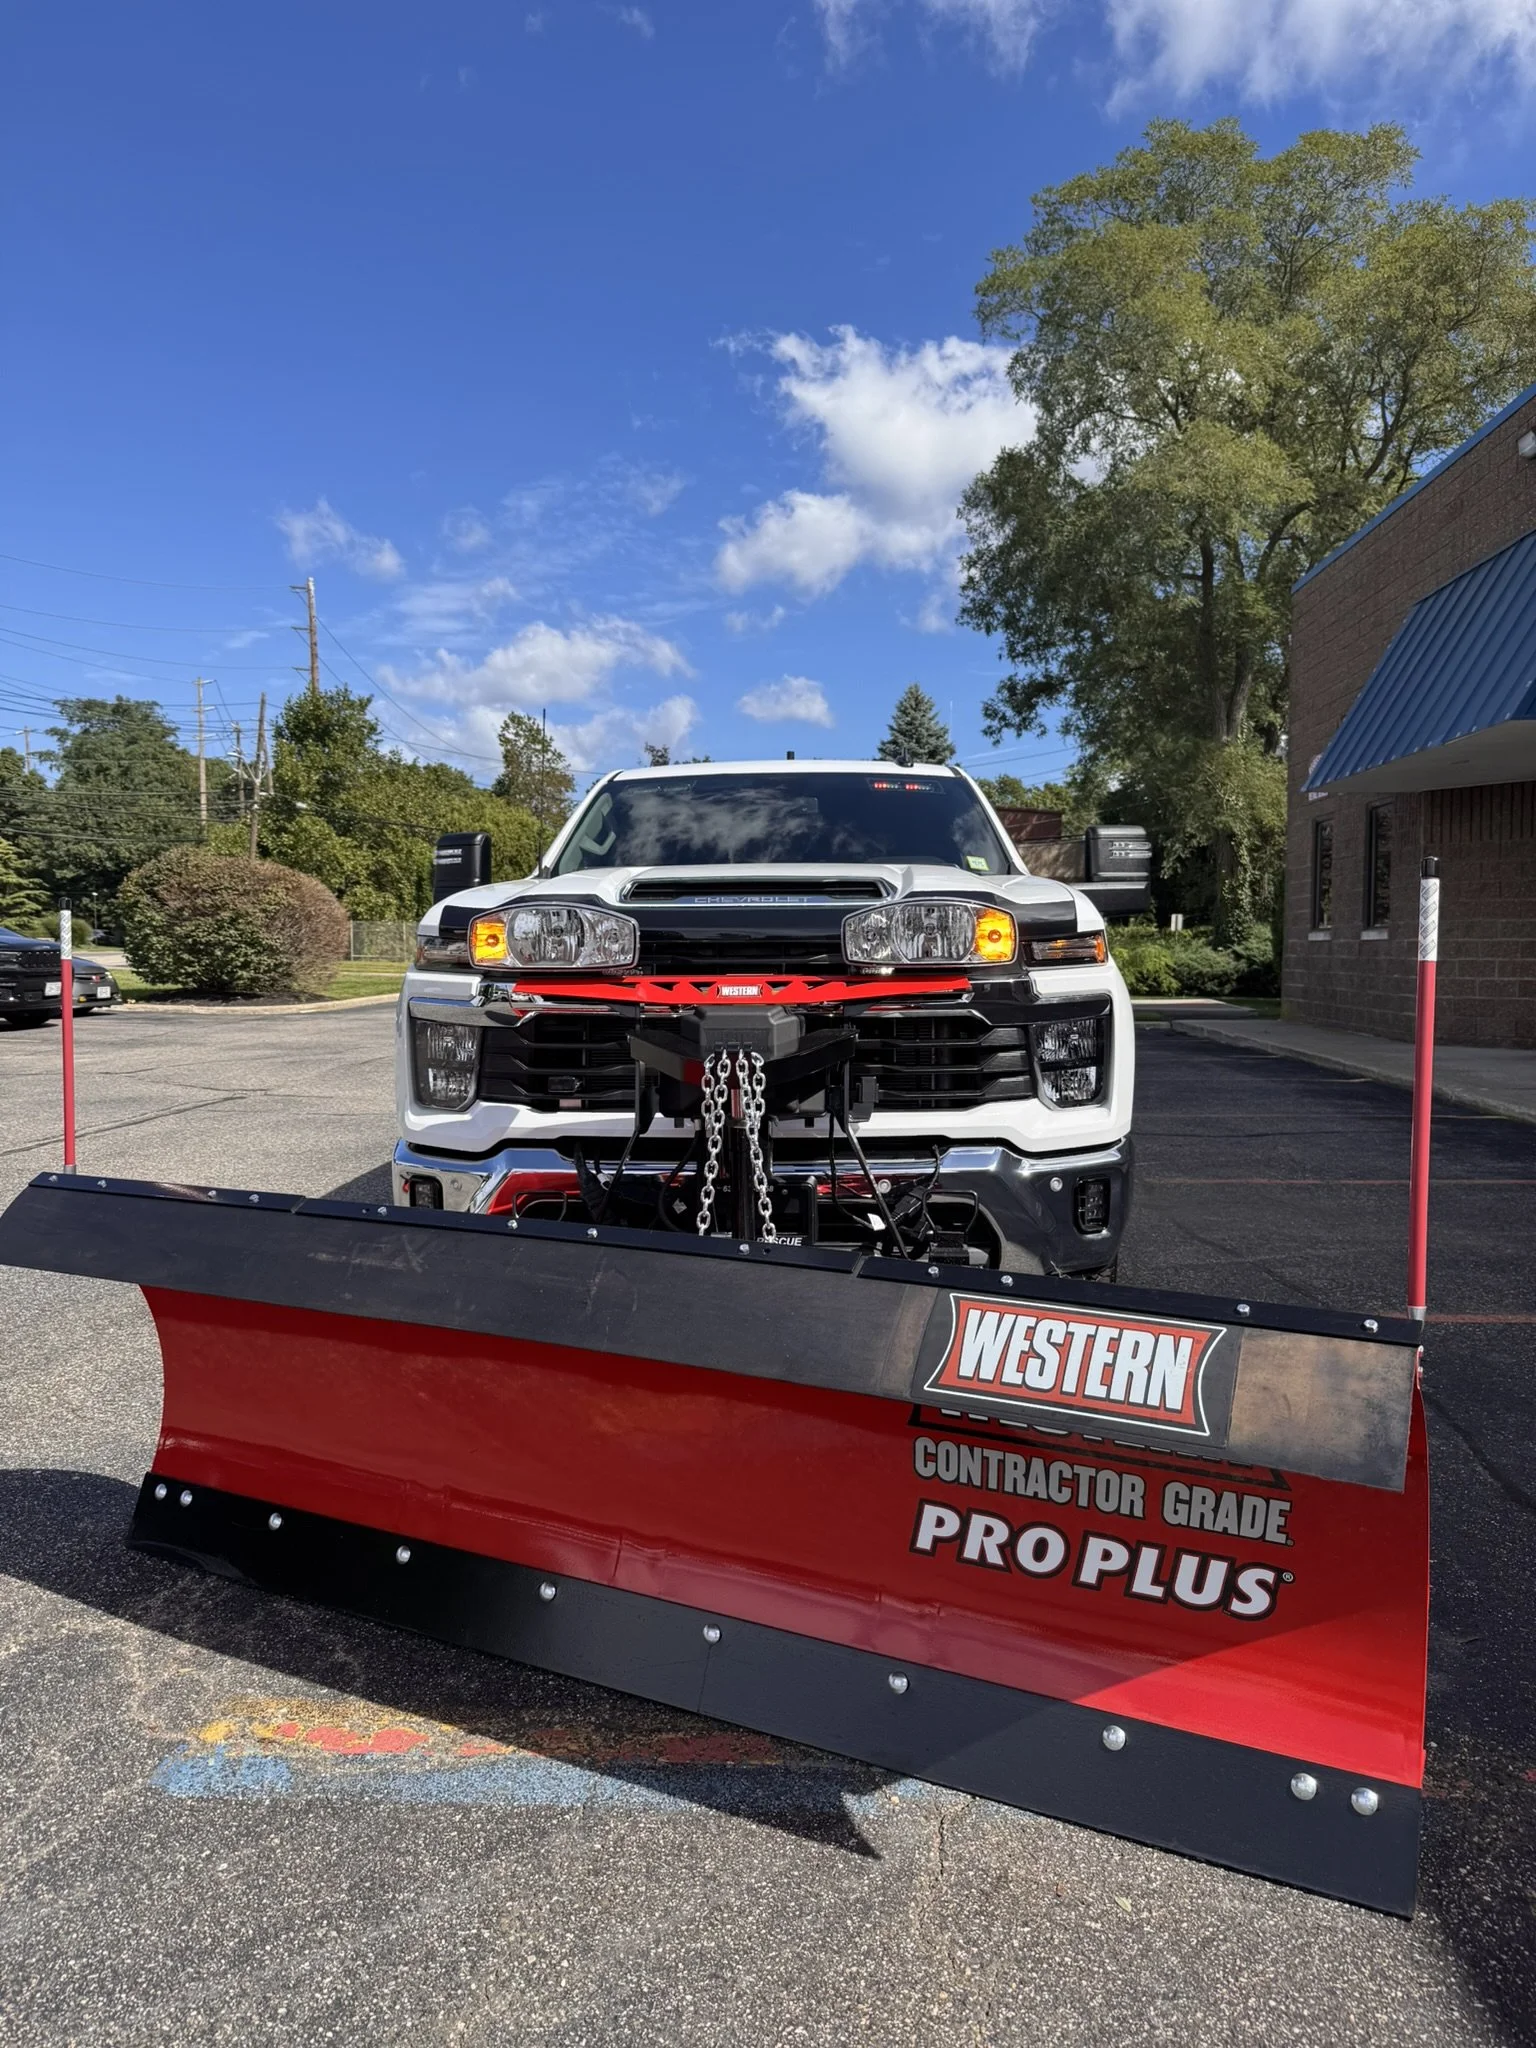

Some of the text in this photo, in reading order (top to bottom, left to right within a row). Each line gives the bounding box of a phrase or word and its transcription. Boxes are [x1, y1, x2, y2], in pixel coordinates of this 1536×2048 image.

[721, 985, 759, 996] WESTERN
[958, 1308, 1194, 1411] WESTERN
[914, 1438, 1145, 1518] CONTRACTOR
[914, 1504, 1066, 1575] PRO
